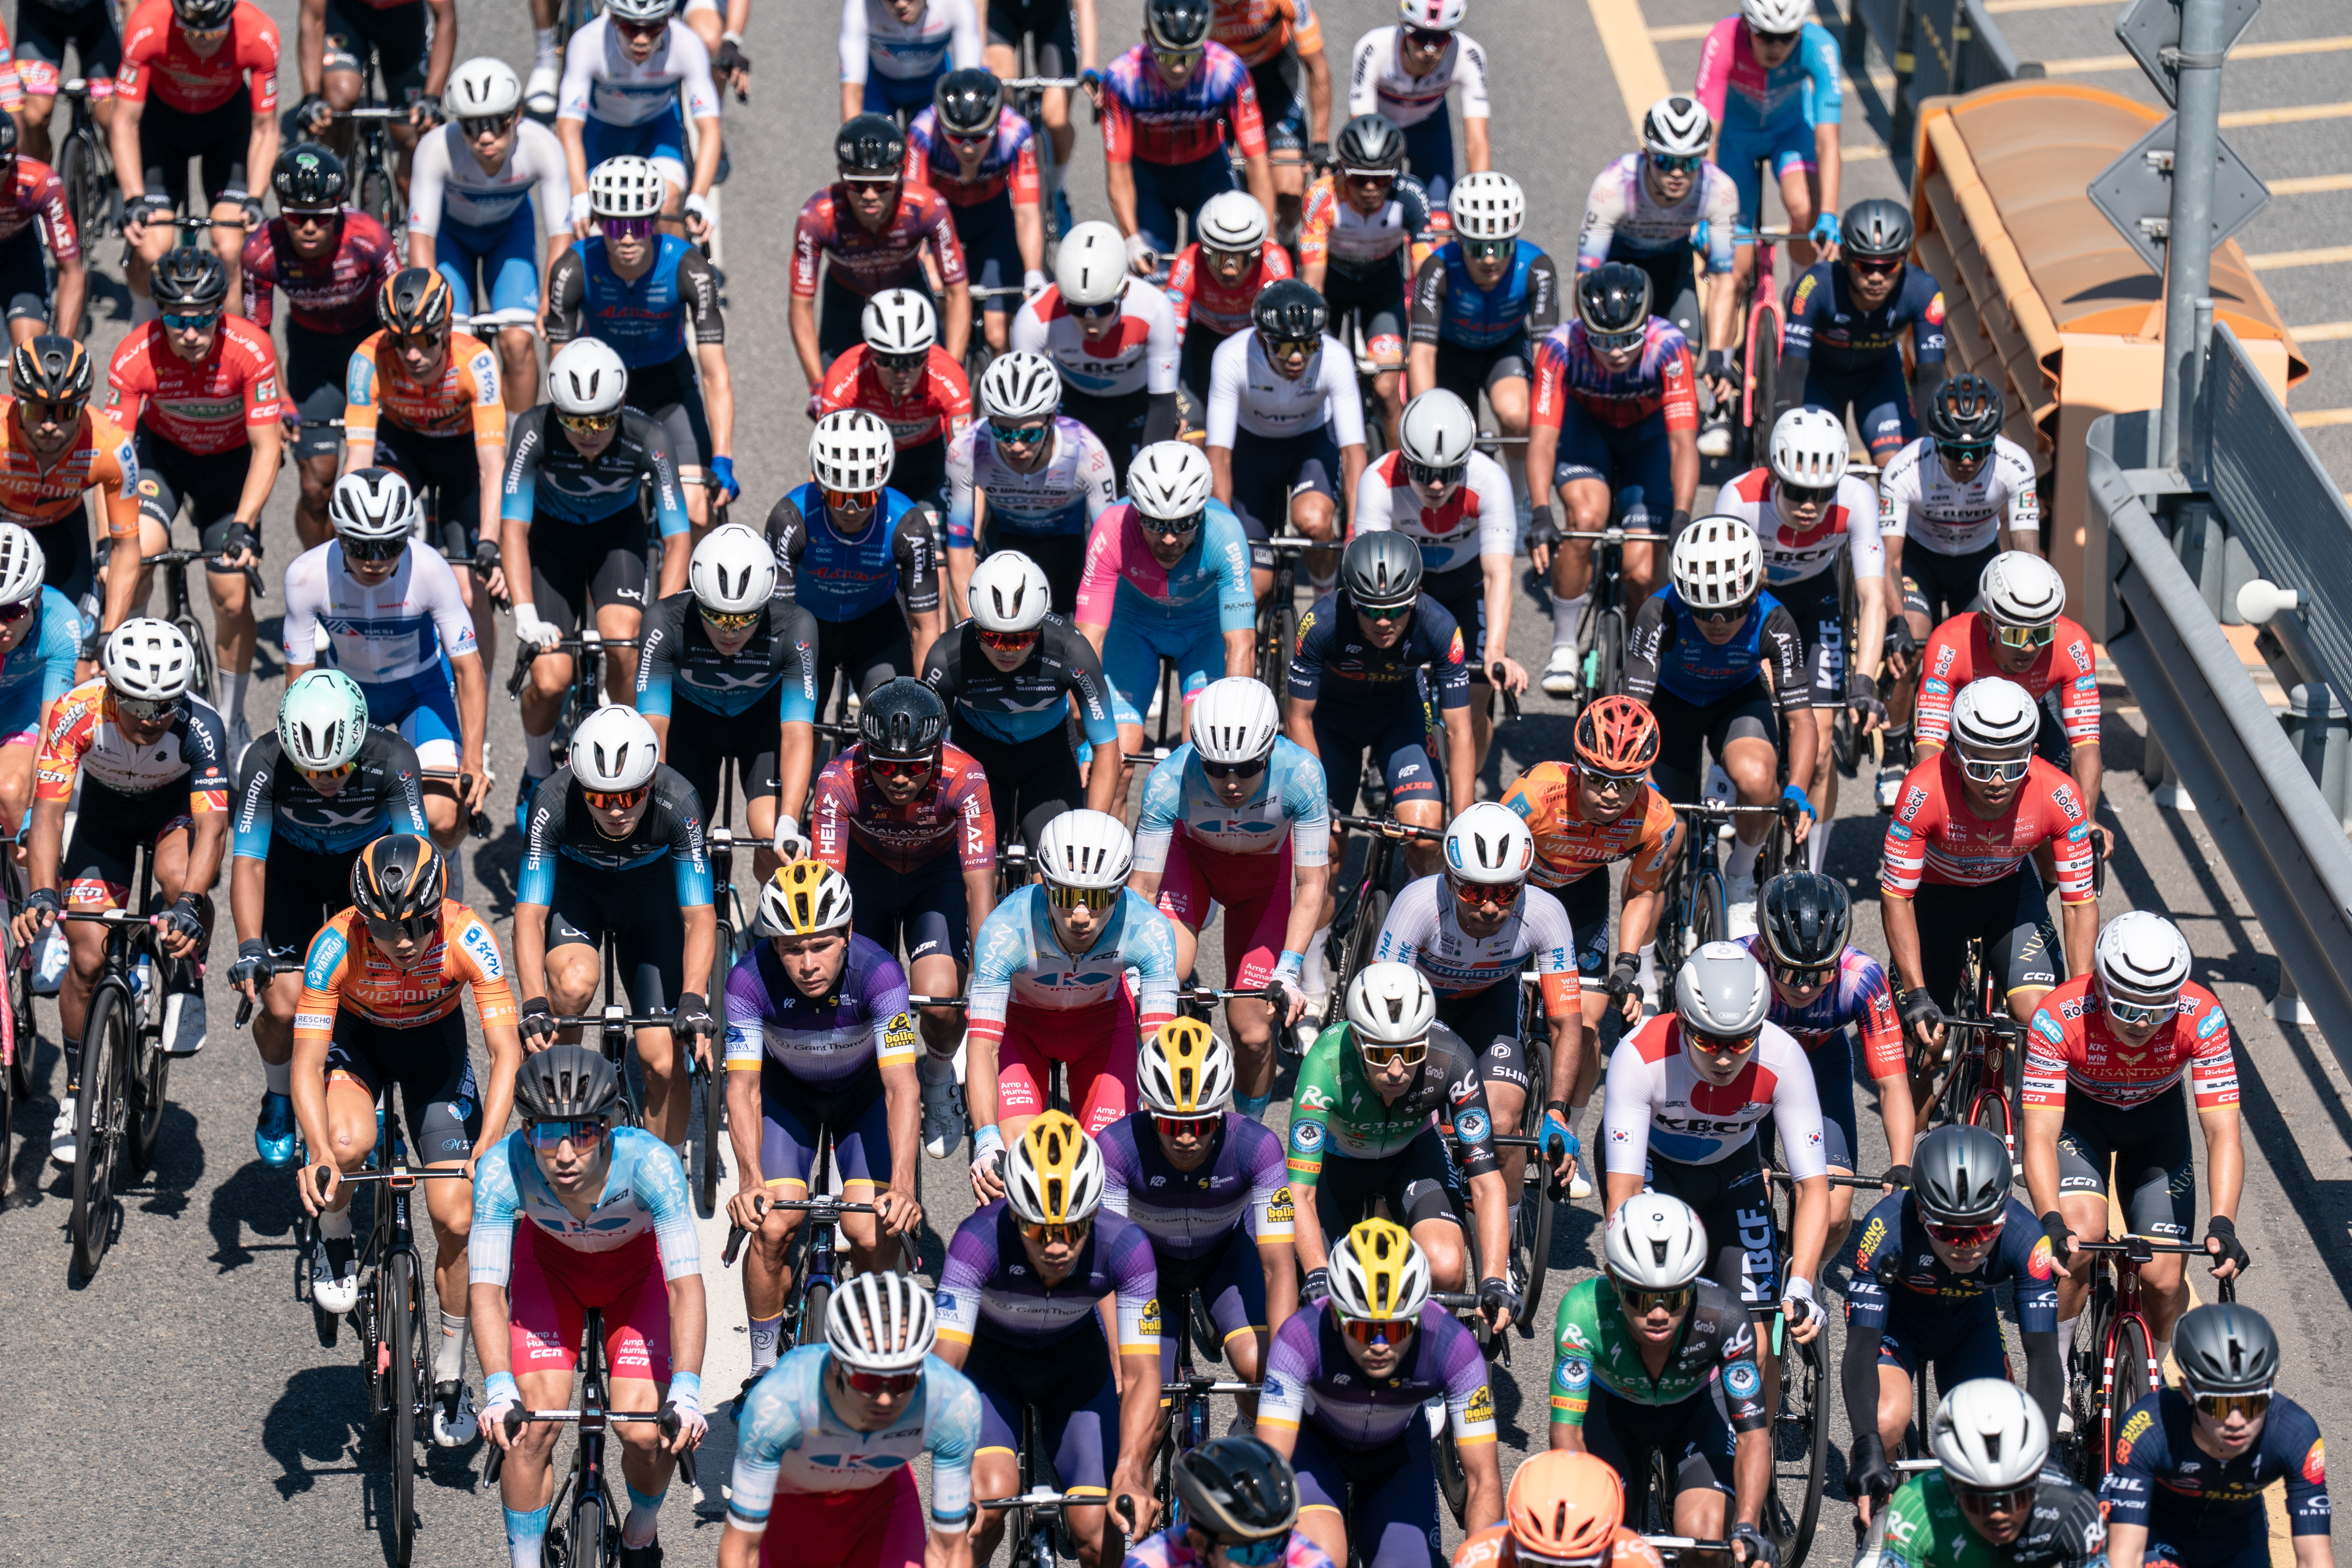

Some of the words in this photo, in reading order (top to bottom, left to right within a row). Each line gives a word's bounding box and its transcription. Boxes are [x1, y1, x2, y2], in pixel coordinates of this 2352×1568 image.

[936, 217, 960, 273] HELAZ
[797, 230, 814, 285] HELAZ
[506, 429, 538, 495] SHIMANO
[1297, 612, 1315, 638] SINO
[637, 628, 664, 693] SHIMANO
[1815, 616, 1842, 691] KBCF.
[1939, 648, 1956, 677] ROCK
[2068, 641, 2087, 672] ROCK
[1047, 658, 1061, 668] 2006
[1925, 681, 1950, 694] KMC
[2075, 675, 2096, 691] KMC
[49, 700, 88, 745] Booster
[189, 717, 218, 763] RUDY
[290, 722, 304, 758] LAZER
[335, 718, 346, 756] LAZER
[1259, 724, 1269, 740] uvex
[195, 775, 228, 786] Magene
[370, 767, 384, 776] 2006
[1300, 758, 1325, 817] KINAN
[1392, 781, 1434, 797] MAXXIS
[238, 770, 269, 834] SHIMANO
[662, 800, 673, 810] 2006
[1903, 787, 1927, 823] ROCK
[820, 793, 839, 854] HELAZ
[865, 825, 945, 835] MALAYSIA
[963, 793, 983, 855] HELAZ
[1890, 824, 1912, 836] KMC
[1947, 823, 1967, 832] KFC
[2013, 824, 2034, 833] ROCK
[2069, 825, 2088, 840] KMC
[528, 807, 550, 871] SHIMANO
[1947, 831, 1966, 840] WIN
[1544, 842, 1625, 862] VICTOIRE
[1940, 842, 2038, 853] NUSANTARA
[1119, 855, 1128, 868] uvex
[420, 854, 439, 905] Kabuto
[911, 940, 937, 958] LAZER
[1146, 917, 1175, 981] KINAN
[1378, 930, 1392, 959] EPIC
[317, 940, 342, 976] YATAGAI
[476, 941, 505, 976] ダイクレ
[1552, 947, 1564, 971] EPIC
[1246, 962, 1267, 974] Amp
[1423, 961, 1523, 979] SHIMANO
[356, 988, 451, 1001] VICTOIRE
[298, 1015, 332, 1024] RESCHO
[2064, 1001, 2099, 1020] ROCK
[1878, 1025, 1900, 1035] SPYDER
[2033, 1013, 2063, 1041] KMC
[2200, 1010, 2226, 1037] KMC
[794, 1044, 826, 1052] Grant
[2088, 1042, 2108, 1052] KFC
[1425, 1065, 1444, 1079] Grab
[1001, 1081, 1021, 1090] Amp
[1002, 1088, 1031, 1096] Human
[1418, 1086, 1434, 1096] PACTO
[1469, 1090, 1481, 1100] cola
[1096, 1106, 1117, 1115] Amp
[1287, 1159, 1321, 1173] PIRELLI
[643, 1164, 666, 1192] Racing
[647, 1146, 688, 1217] KINAN
[1860, 1217, 1883, 1251] SINO
[1867, 1226, 1887, 1258] PACIFIC
[1737, 1199, 1772, 1302] KBCF.
[526, 1331, 550, 1340] Amp
[1693, 1320, 1715, 1334] Grab
[526, 1339, 561, 1348] Human
[620, 1346, 653, 1356] Human
[622, 1339, 645, 1348] Amp
[1689, 1342, 1706, 1352] PACTO
[2121, 1410, 2150, 1439] SINO
[2127, 1418, 2153, 1445] PACIFIC
